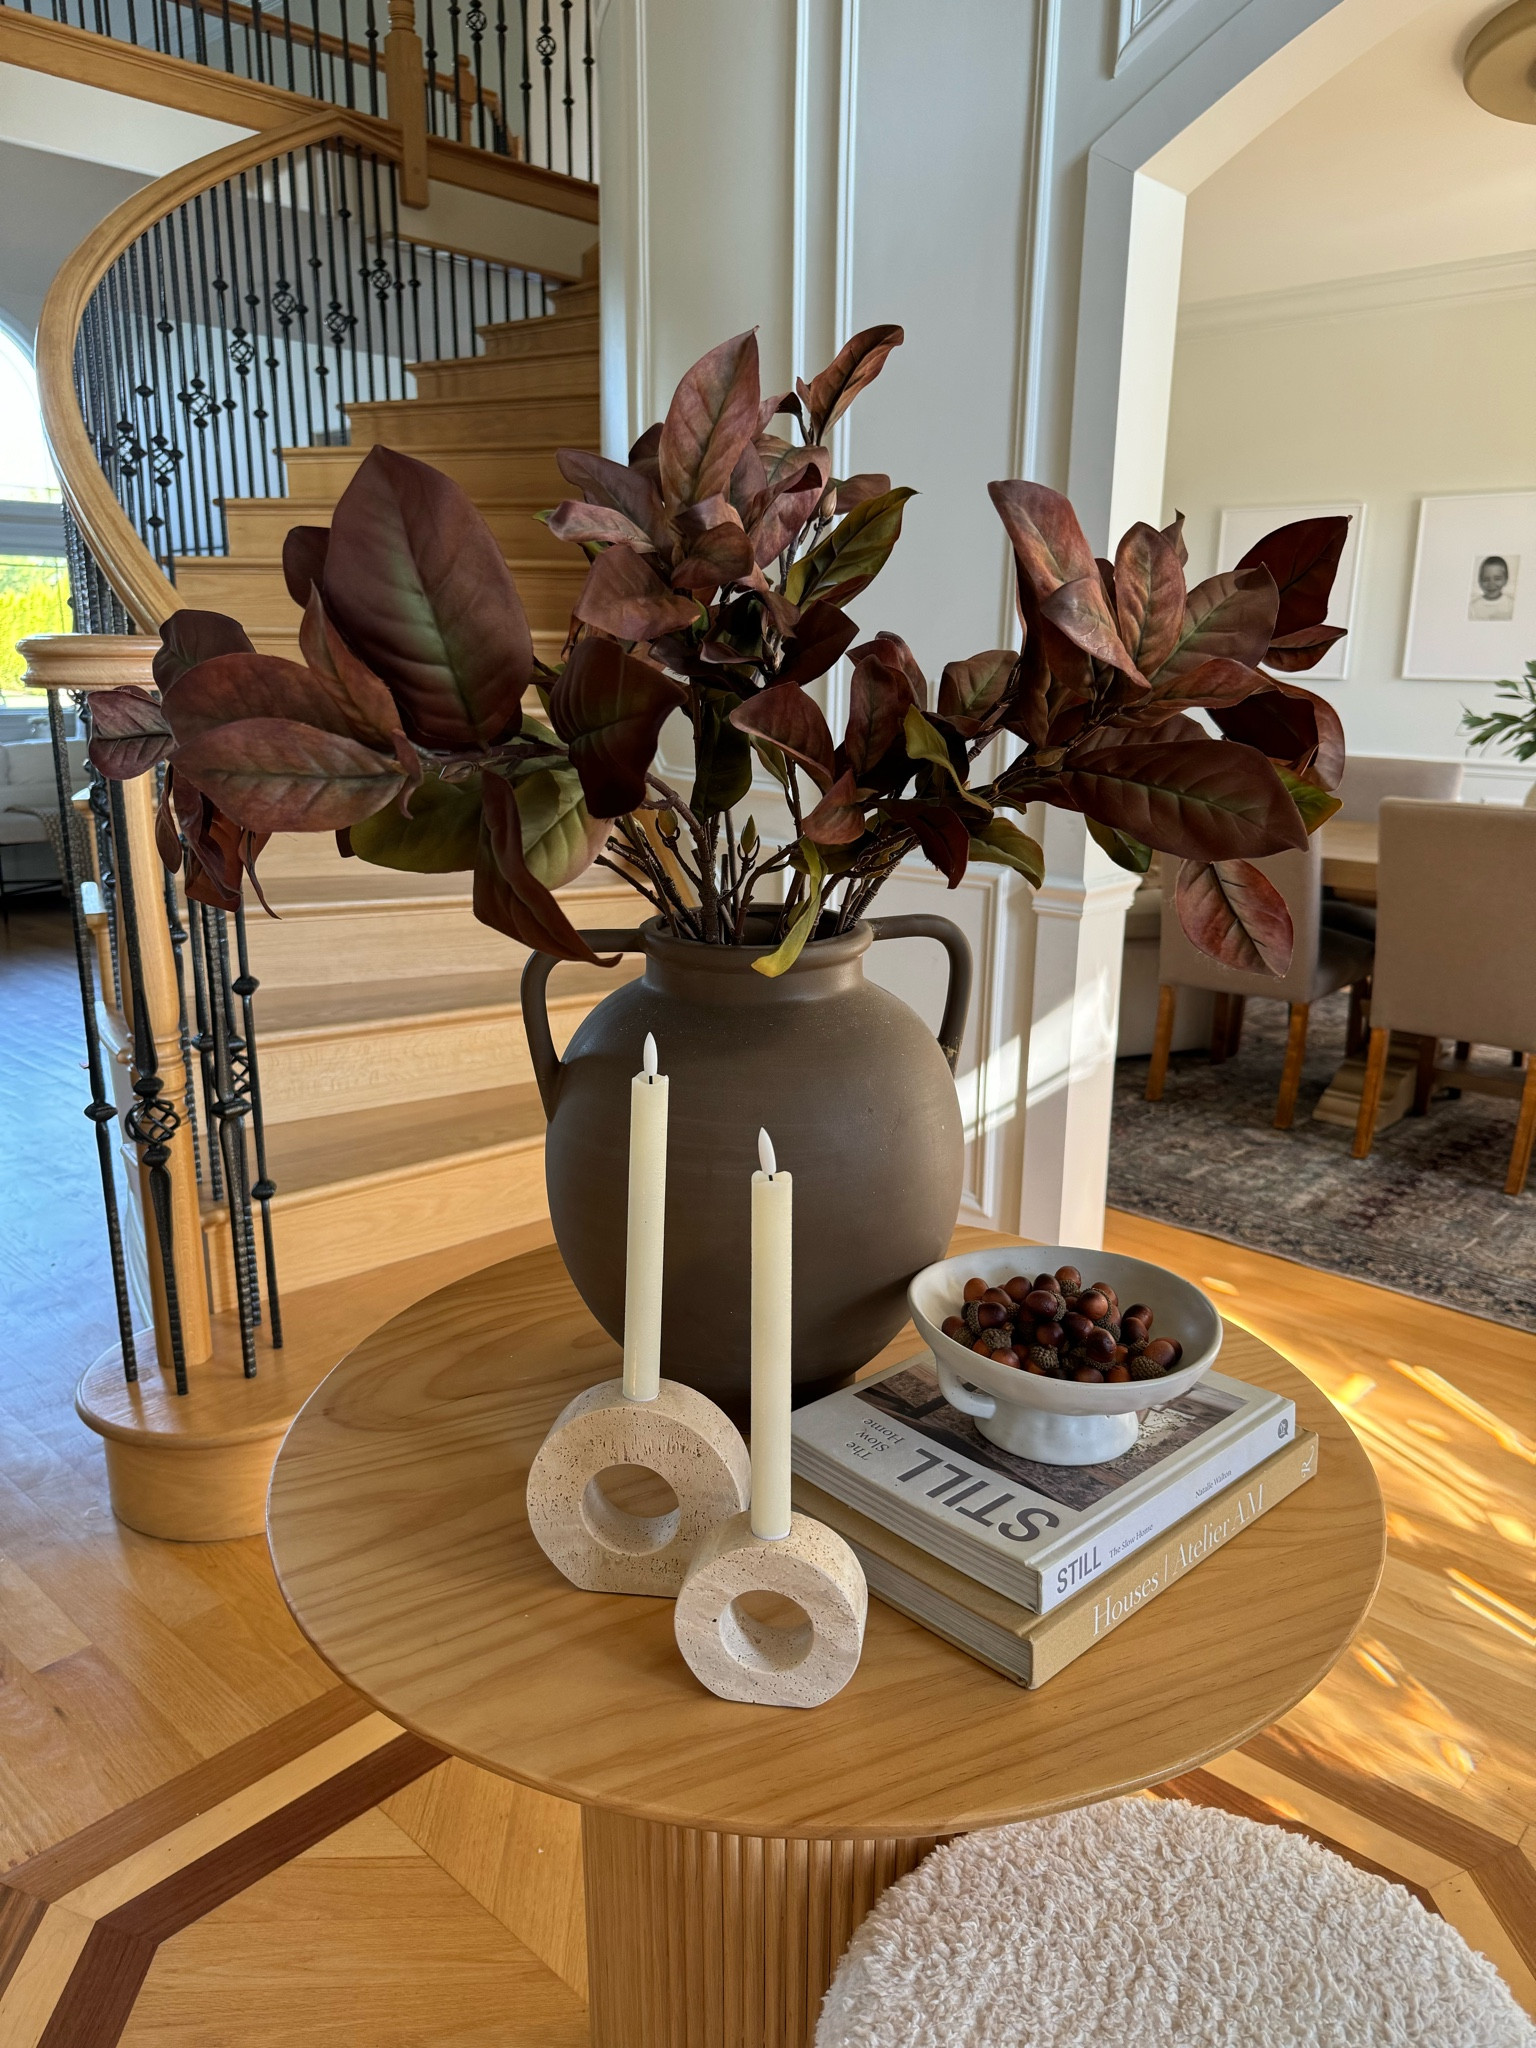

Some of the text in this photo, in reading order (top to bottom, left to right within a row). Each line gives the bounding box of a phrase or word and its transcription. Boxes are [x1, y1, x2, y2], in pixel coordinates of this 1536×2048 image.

[846, 1441, 872, 1460] The
[856, 1428, 889, 1452] Slow
[863, 1418, 905, 1444] Home
[896, 1447, 1060, 1542] STILL
[1056, 1546, 1102, 1594] STILL
[1109, 1545, 1121, 1558] The
[1121, 1535, 1136, 1550] Slow
[1136, 1523, 1154, 1540] Home
[1195, 1482, 1214, 1499] Natalie
[1093, 1571, 1159, 1637] Houses
[1172, 1517, 1230, 1577] Atelier
[1230, 1483, 1263, 1532] AM
